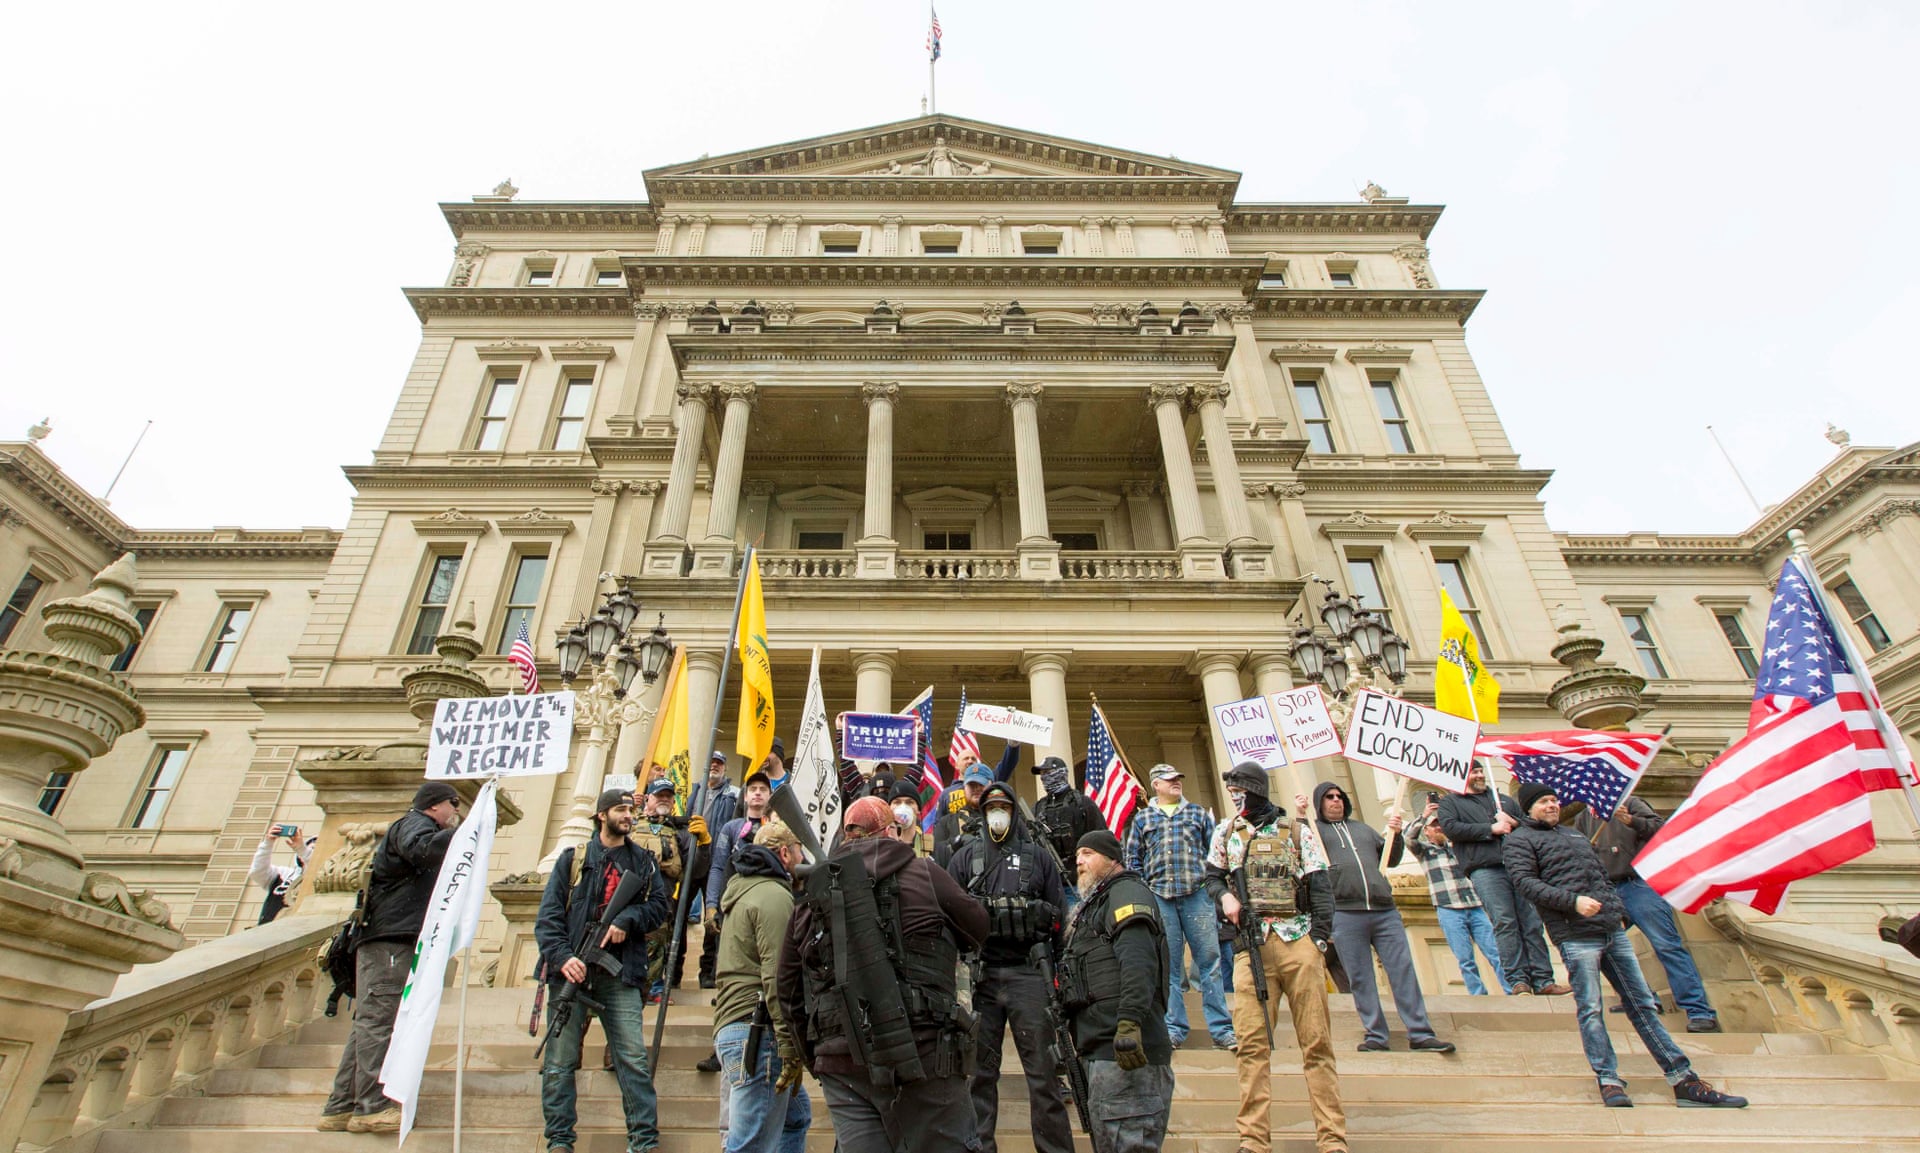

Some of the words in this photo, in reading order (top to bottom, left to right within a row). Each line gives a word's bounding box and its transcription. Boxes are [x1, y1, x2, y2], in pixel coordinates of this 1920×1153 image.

[443, 697, 545, 723] REMOVE
[547, 696, 567, 716] THE
[1221, 705, 1265, 727] OPEN
[1278, 690, 1317, 716] STOP
[1294, 715, 1316, 727] the
[1361, 693, 1424, 732] END
[1436, 728, 1460, 743] THE
[435, 720, 551, 746] WHITMER
[848, 725, 912, 738] TRUMP
[854, 736, 906, 745] PENCE
[1228, 733, 1278, 754] MICHIGAN
[445, 743, 546, 775] REGIME
[1357, 726, 1469, 781] LOCKDOWN
